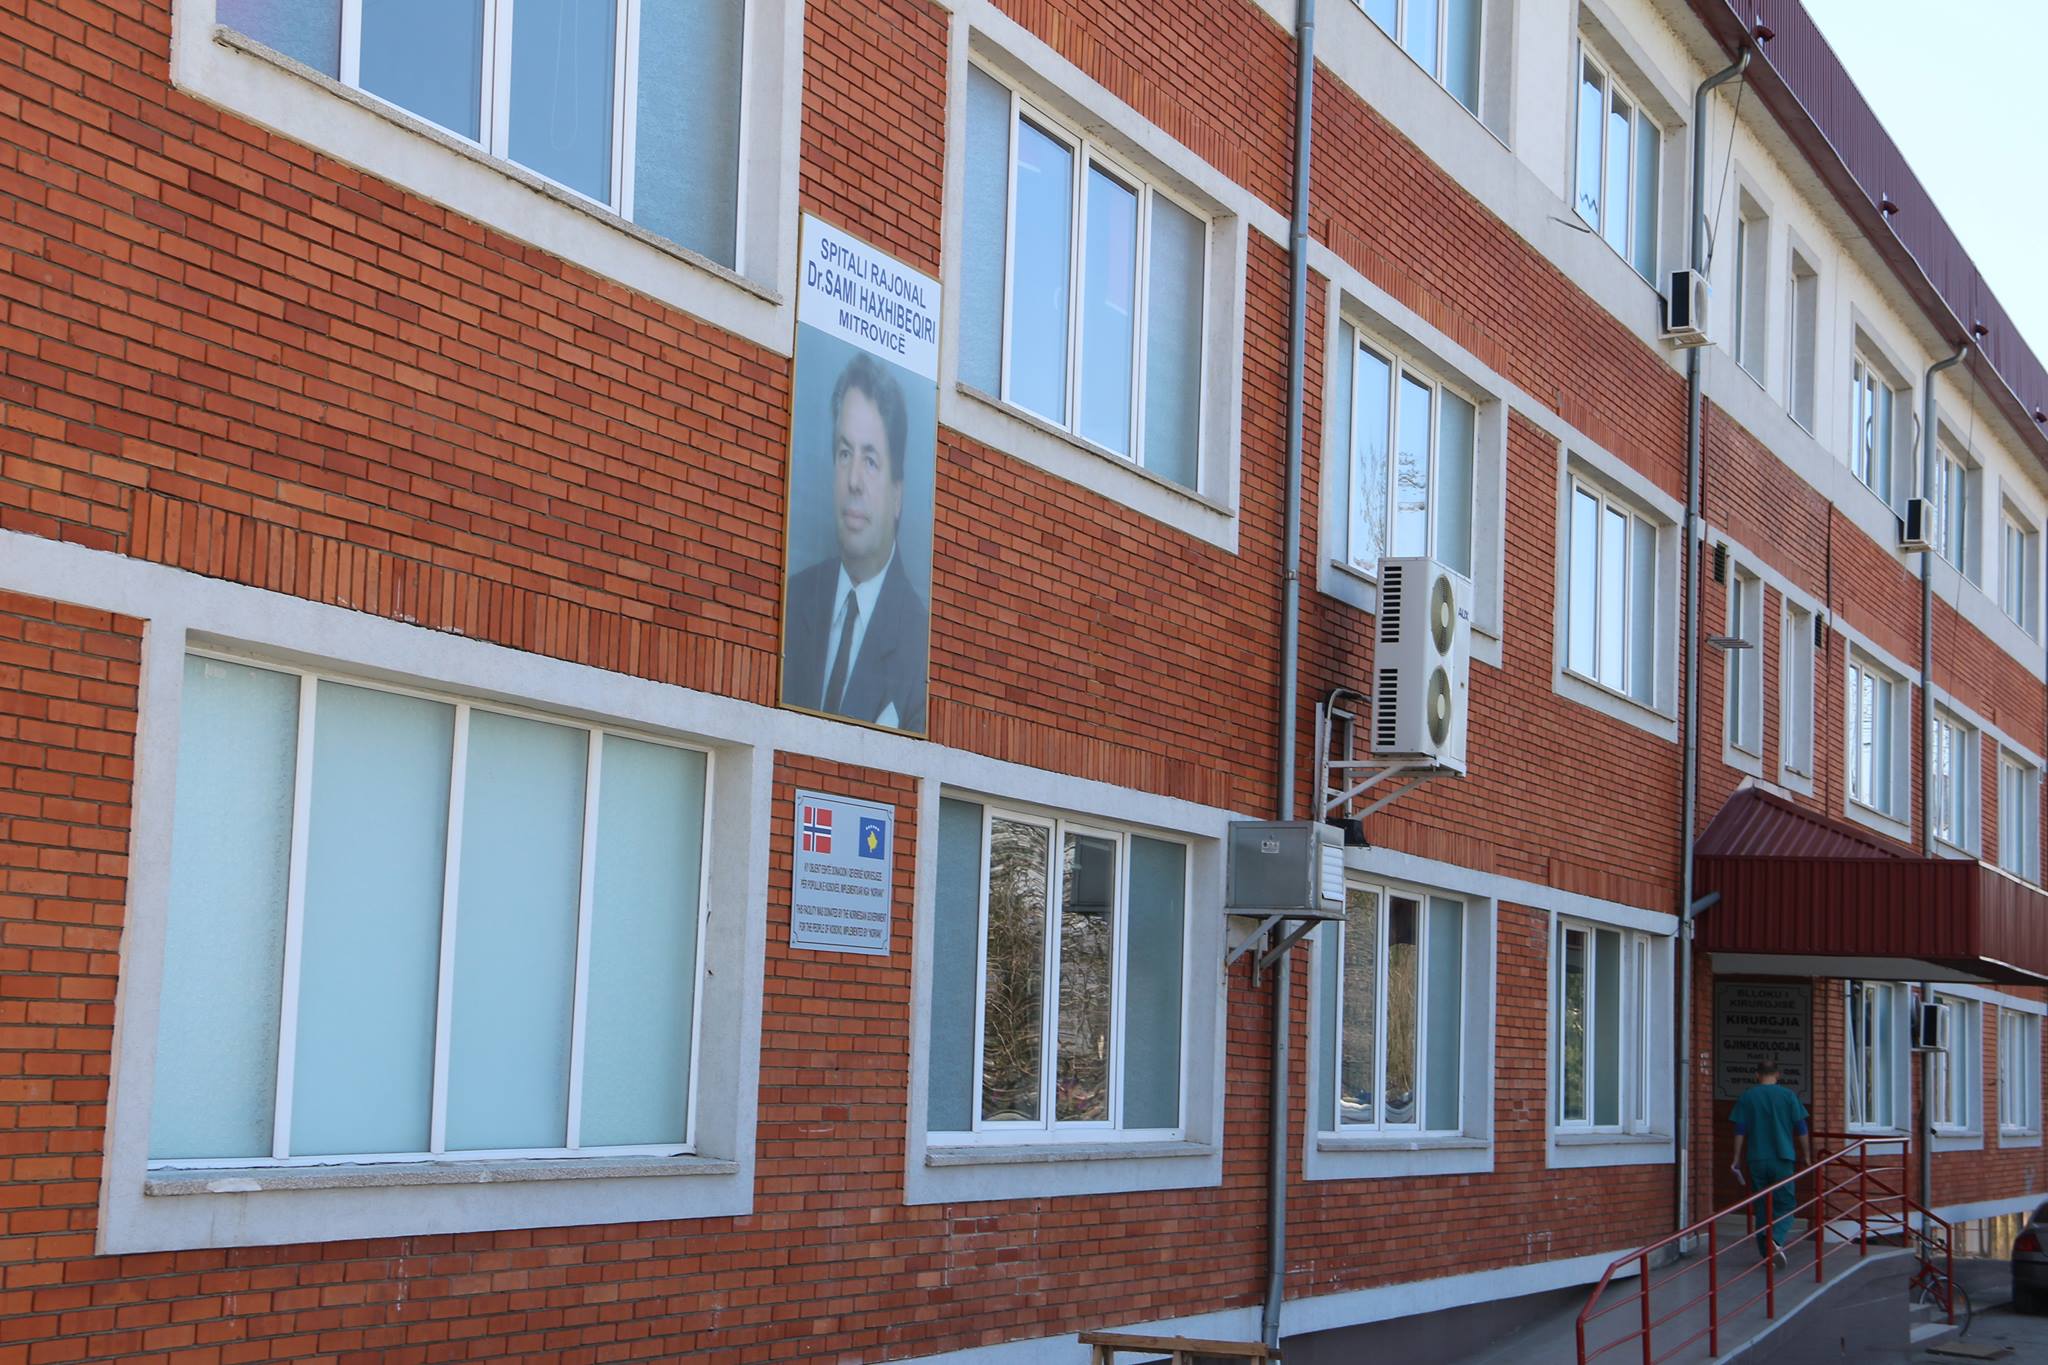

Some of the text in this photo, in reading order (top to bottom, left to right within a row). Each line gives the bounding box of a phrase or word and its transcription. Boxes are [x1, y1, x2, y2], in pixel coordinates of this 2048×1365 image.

[821, 238, 926, 309] SPITALI RAJONAL
[839, 309, 906, 355] MITROVICË
[859, 286, 936, 344] HAXHIBEQIRI
[1726, 1015, 1800, 1027] KIRURGJIA
[1723, 1040, 1801, 1052] GJINEKOLOGJIA
